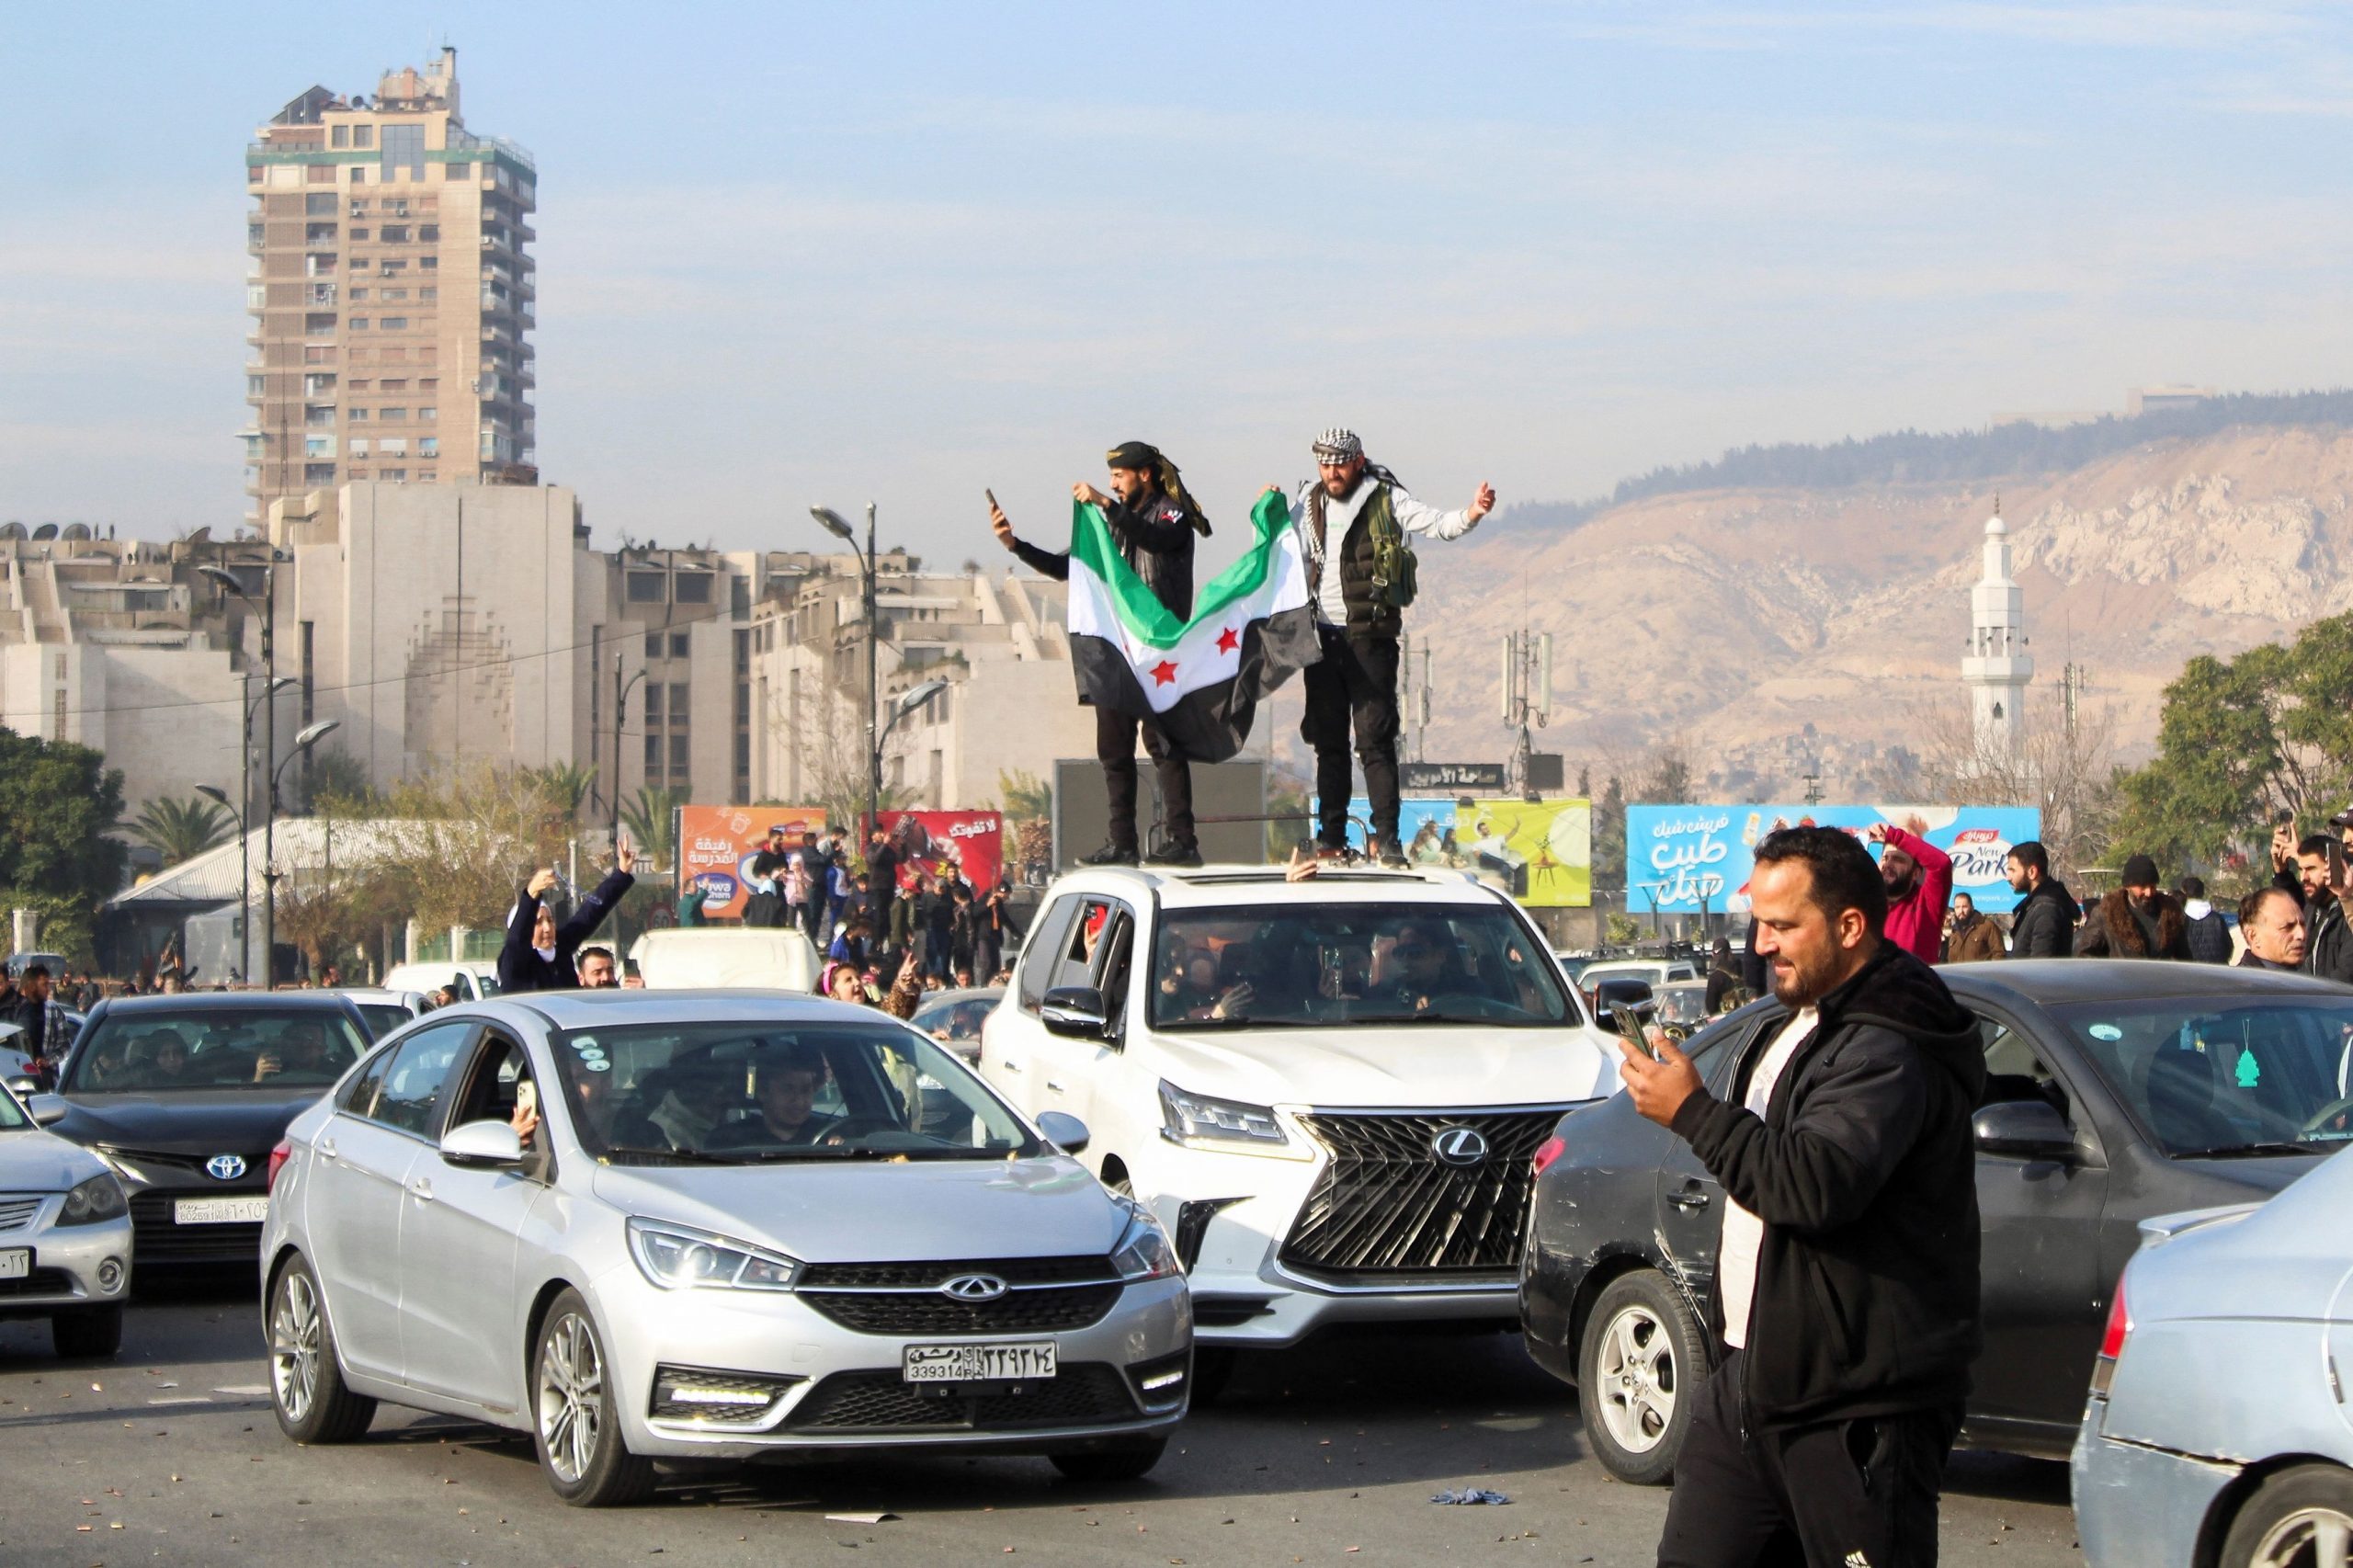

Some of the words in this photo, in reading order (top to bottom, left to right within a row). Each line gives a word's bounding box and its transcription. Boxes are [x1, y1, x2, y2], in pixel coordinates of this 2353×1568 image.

[985, 819, 996, 833] لا
[1653, 820, 1687, 838] شيك
[1687, 813, 1729, 834] فريش
[695, 837, 732, 854] رفيقة
[1651, 833, 1728, 876] طيب
[1975, 846, 2002, 857] New
[689, 850, 738, 867] المدرسة
[1949, 851, 2007, 876] Park
[698, 880, 733, 892] Hwa
[1654, 867, 1724, 906] هيك
[909, 1348, 962, 1364] دمشق
[983, 1347, 1053, 1377] ٣٣٩٣١٤
[964, 1348, 974, 1378] SYR
[911, 1364, 963, 1379] 339314
